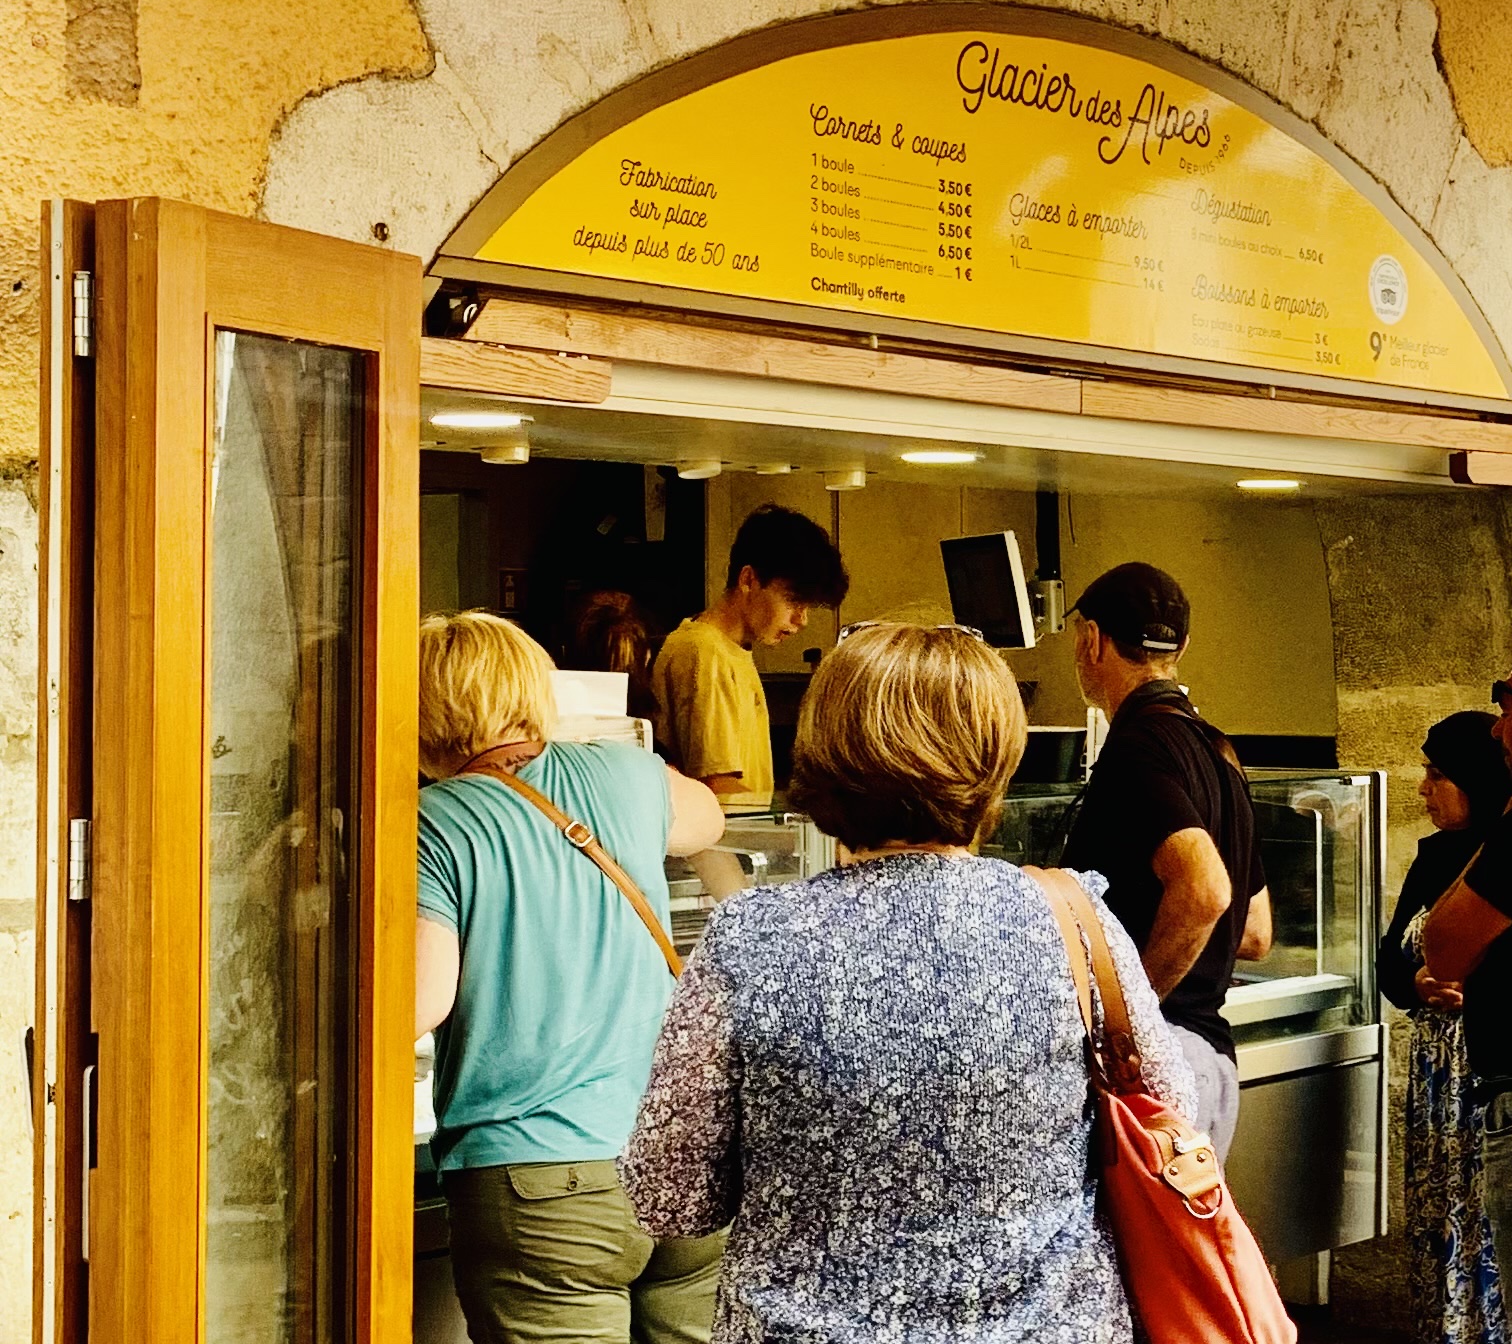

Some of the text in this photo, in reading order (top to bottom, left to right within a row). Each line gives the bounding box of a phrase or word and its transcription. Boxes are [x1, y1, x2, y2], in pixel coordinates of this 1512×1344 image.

[957, 41, 1211, 165] Glacier des Alpes
[810, 103, 967, 166] Cornets & coupes
[811, 153, 817, 166] 1
[821, 154, 855, 174] boule
[1179, 156, 1216, 176] DEPUIS
[619, 159, 718, 200] Fabrication
[810, 175, 818, 190] 2
[821, 177, 861, 198] boules
[629, 199, 709, 230] sur place
[810, 198, 818, 212] 3
[821, 200, 861, 220] boules
[1009, 193, 1149, 241] Glaces à emporter
[1191, 188, 1273, 227] Dégustation
[810, 221, 818, 235] 4
[821, 223, 861, 242] boules
[1010, 233, 1033, 251] 1/2L
[573, 225, 760, 273] depuis plus de 50 ans
[810, 242, 845, 261] Boule
[847, 250, 934, 276] supplémentaire
[1010, 255, 1021, 269] 1L
[810, 277, 906, 303] Chantilly offerte
[1191, 273, 1330, 320] Boissons à emporter
